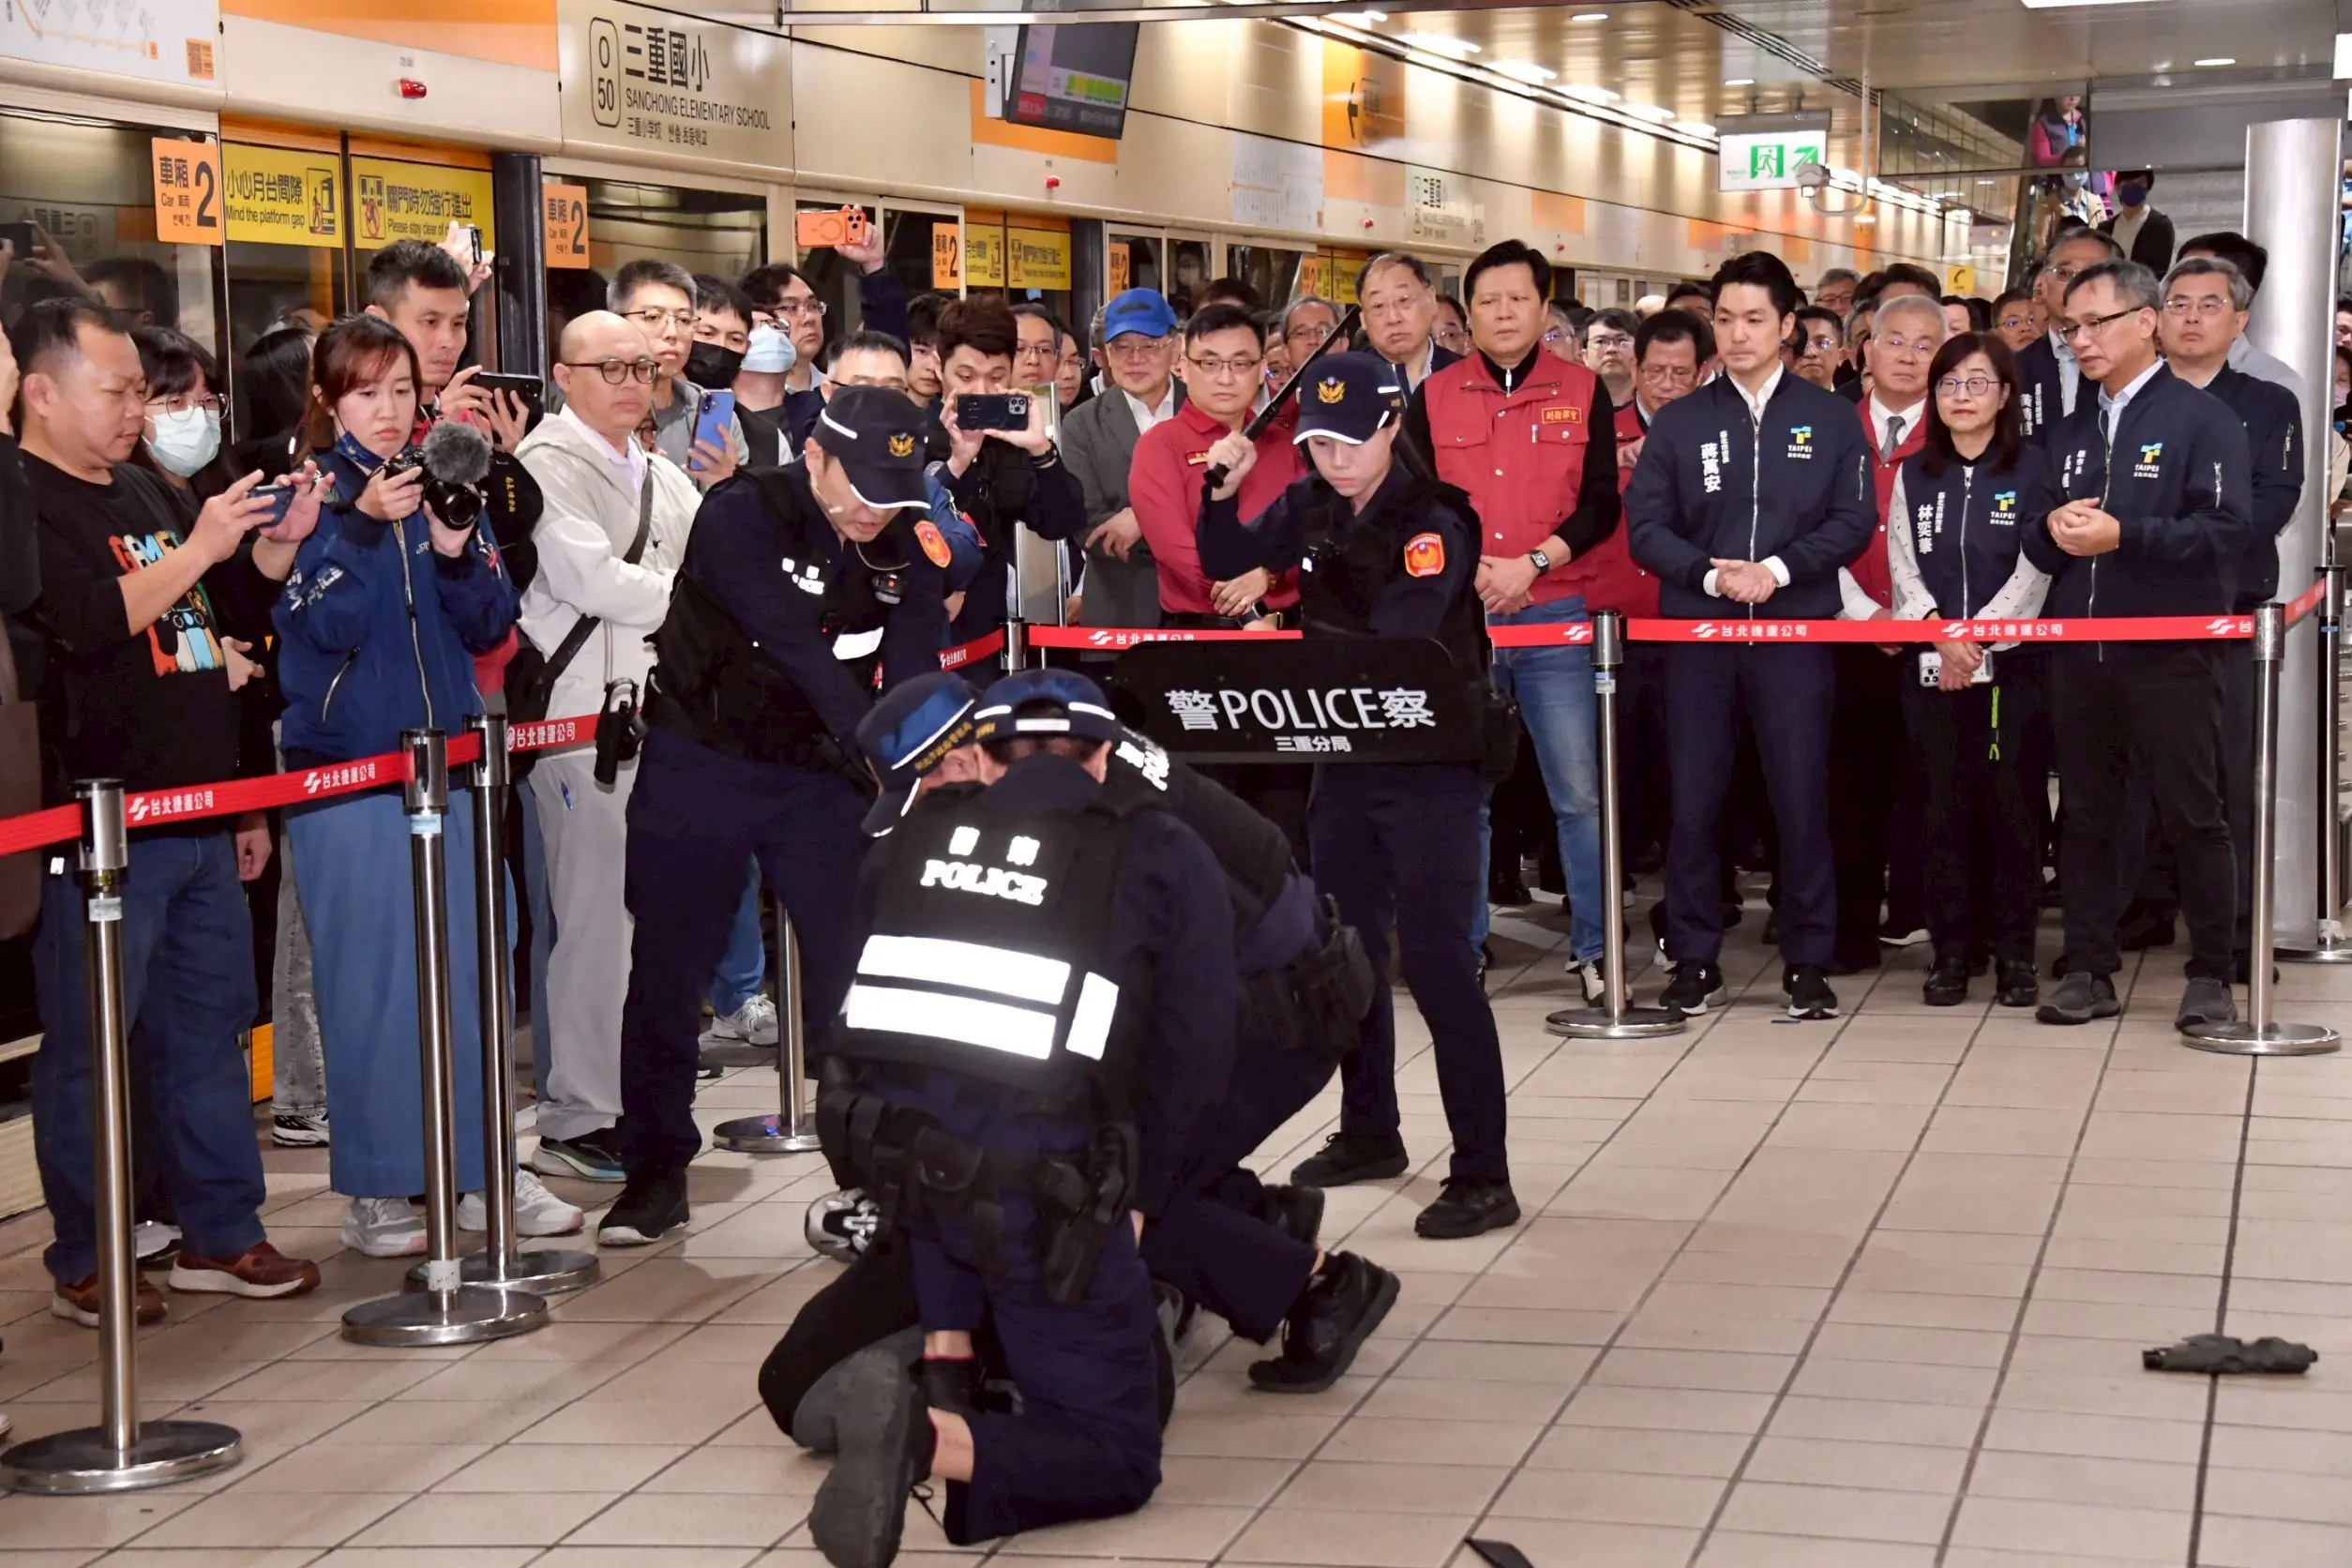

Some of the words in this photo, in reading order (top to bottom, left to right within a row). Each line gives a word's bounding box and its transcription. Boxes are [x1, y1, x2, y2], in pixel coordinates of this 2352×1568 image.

[625, 24, 710, 92] 三重國小
[597, 77, 614, 112] 50
[626, 87, 677, 116] SANCHONG
[679, 97, 734, 124] ELEMENTARY
[736, 106, 771, 130] SCHOOL
[158, 156, 189, 189] 車廂
[226, 170, 303, 204] 小心月台間隙
[160, 192, 174, 207] Car
[194, 160, 217, 228] 2
[386, 184, 473, 219] 關門時勿強行進出
[225, 205, 245, 223] Mind
[246, 209, 258, 224] the
[259, 208, 290, 227] platform
[291, 214, 306, 229] gap
[387, 218, 408, 234] Please
[571, 201, 586, 255] 2
[949, 235, 958, 278] 2
[1787, 445, 1813, 453] TAIPEI
[1700, 442, 1722, 493] 蔣萬安
[2134, 463, 2160, 473] TAIPEI
[1917, 504, 1934, 554] 林奕華
[1989, 511, 2016, 520] TAIPEI
[1721, 625, 1807, 638] 台北捷運公司
[1972, 624, 2063, 638] 台北捷運公司
[1164, 686, 1437, 731] 警POLICE察
[517, 721, 576, 748] 台北捷運公司
[1274, 735, 1352, 752] 三重分局
[322, 762, 376, 790] 台北捷運公司
[150, 790, 215, 818] 台北捷運公司
[920, 859, 1048, 906] POLICE
